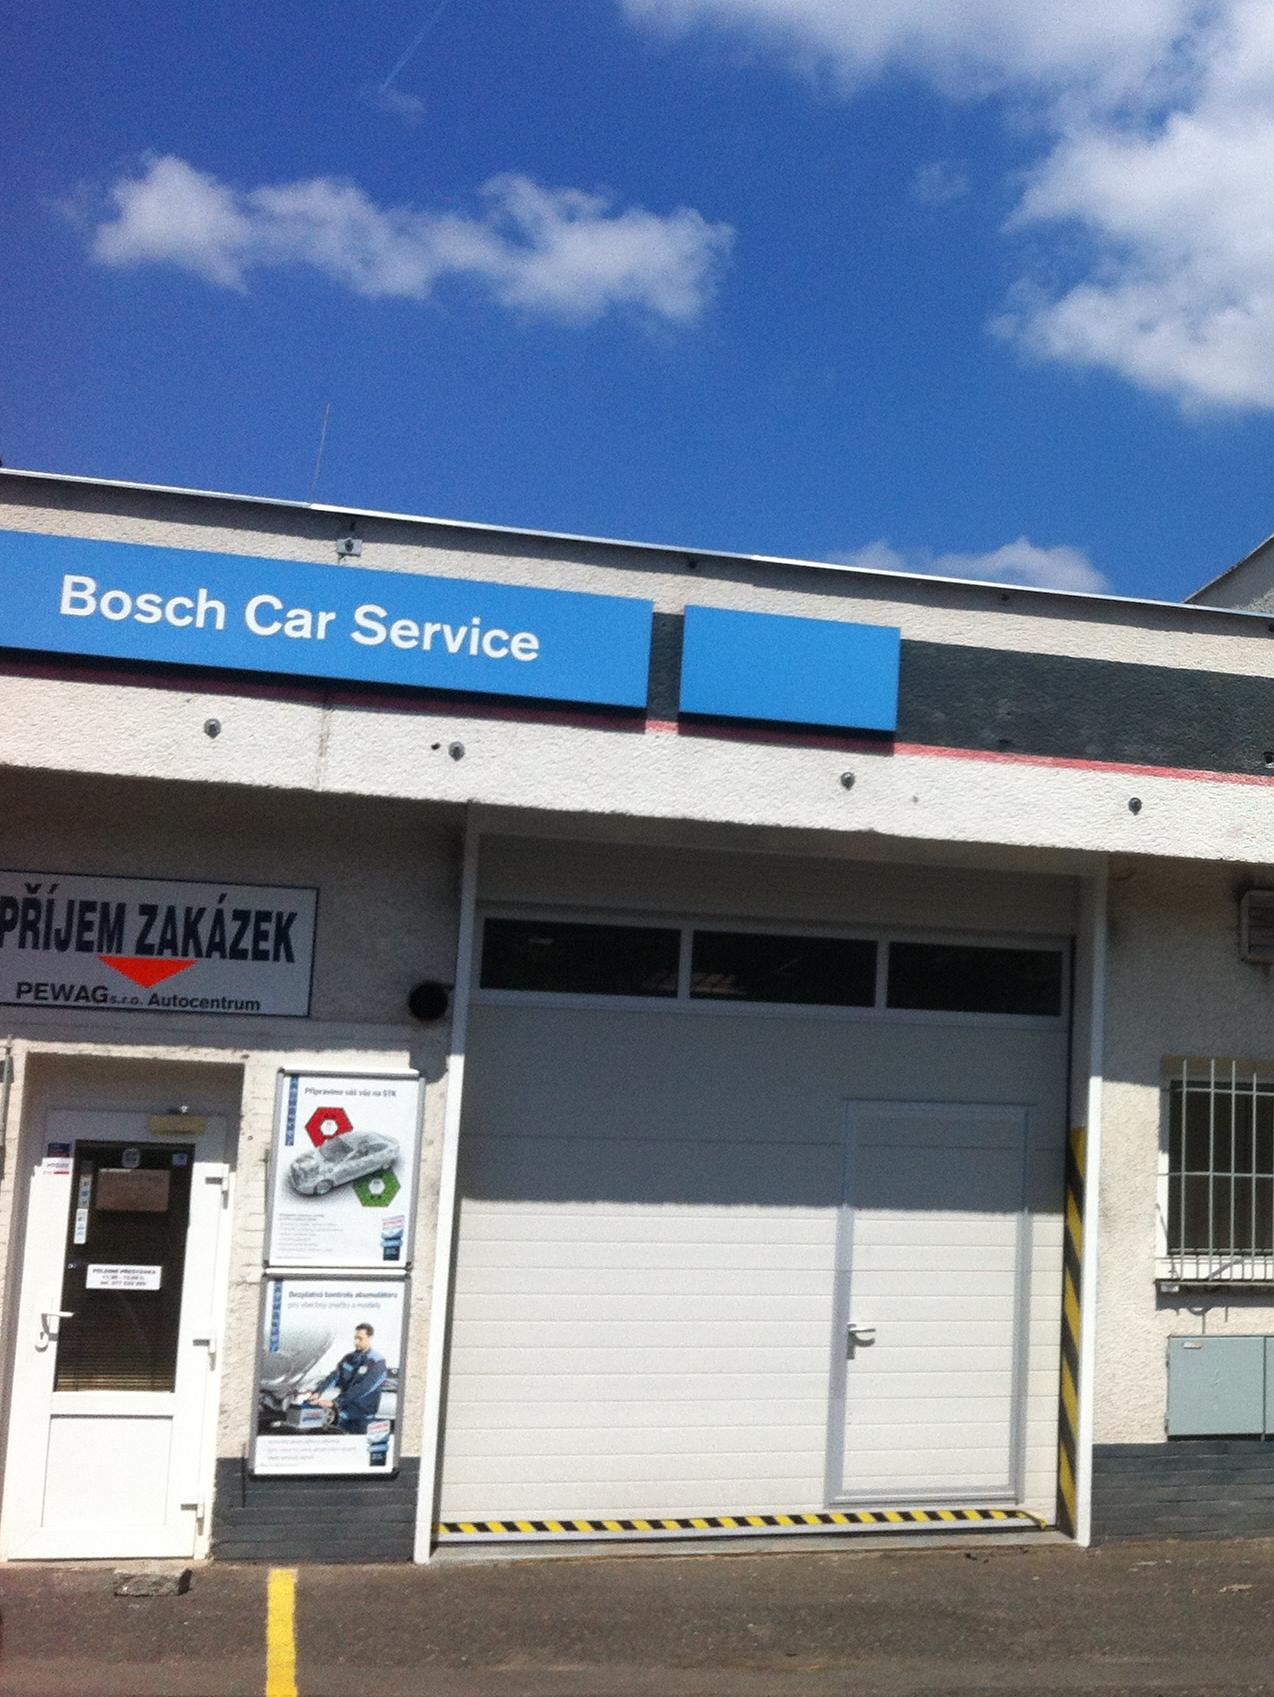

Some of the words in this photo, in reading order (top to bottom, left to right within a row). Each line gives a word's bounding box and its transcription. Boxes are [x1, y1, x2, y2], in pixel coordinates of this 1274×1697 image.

[59, 573, 227, 631] Bosch
[244, 593, 337, 641] Car
[350, 603, 541, 662] Service
[0, 882, 126, 954] PŘÍJEM
[135, 892, 298, 963] ZAKÁZEK
[15, 981, 109, 1005] PEWAG
[148, 992, 261, 1012] Autocentrum
